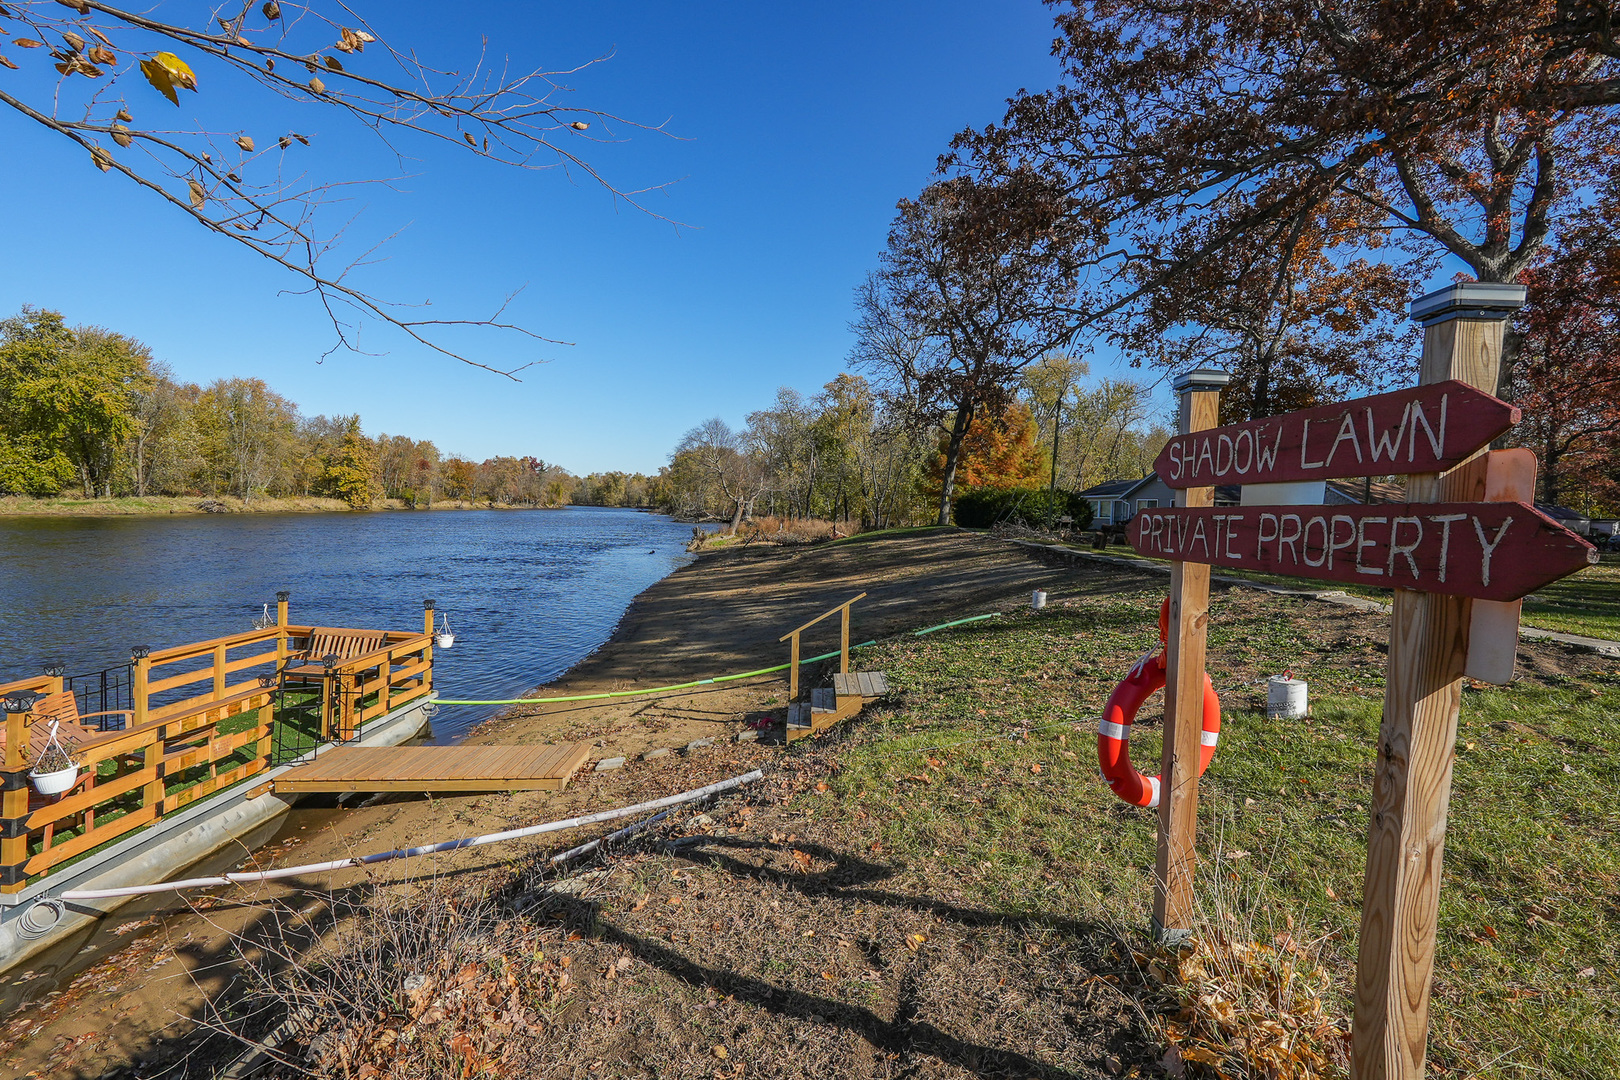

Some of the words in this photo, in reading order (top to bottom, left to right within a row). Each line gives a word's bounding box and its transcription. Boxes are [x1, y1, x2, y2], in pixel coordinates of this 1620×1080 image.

[1169, 426, 1283, 480] SHADOW
[1301, 393, 1448, 469] LAWN
[1138, 514, 1243, 559] PRIVATE
[1257, 514, 1514, 587] PROPERTY
